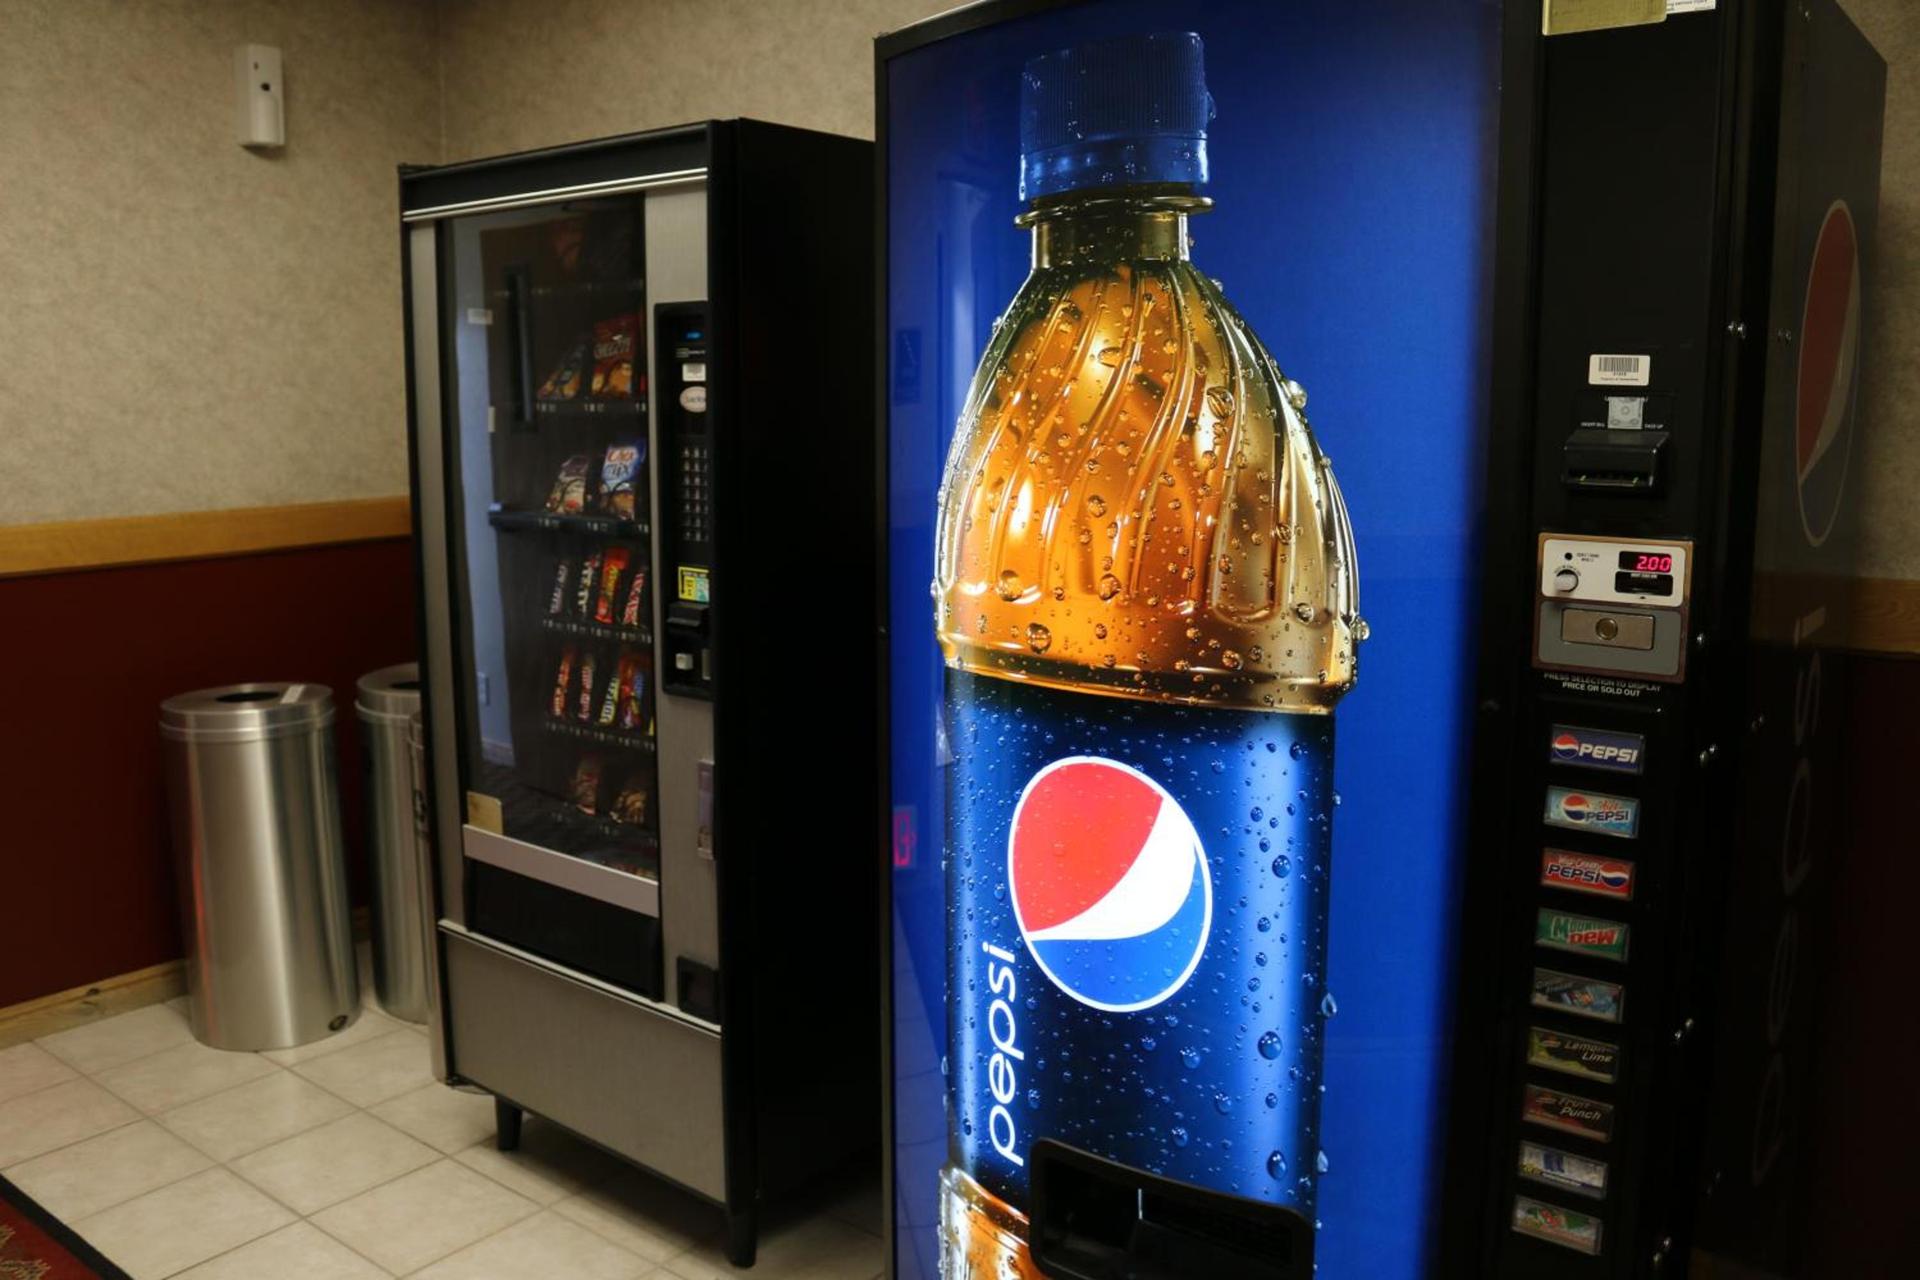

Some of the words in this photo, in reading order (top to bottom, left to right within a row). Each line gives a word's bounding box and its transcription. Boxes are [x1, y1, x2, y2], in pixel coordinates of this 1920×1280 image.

[1637, 556, 1671, 571] 2.00
[1562, 682, 1585, 691] PRICE
[1587, 684, 1599, 692] OR
[1601, 686, 1622, 695] SOLD
[1624, 688, 1641, 697] OUT
[1578, 743, 1639, 763] PEPSI
[1585, 810, 1629, 823] PEPSI
[1548, 863, 1601, 883] PEPSI
[982, 941, 1024, 1166] pepsi
[1559, 1107, 1602, 1120] Punch
